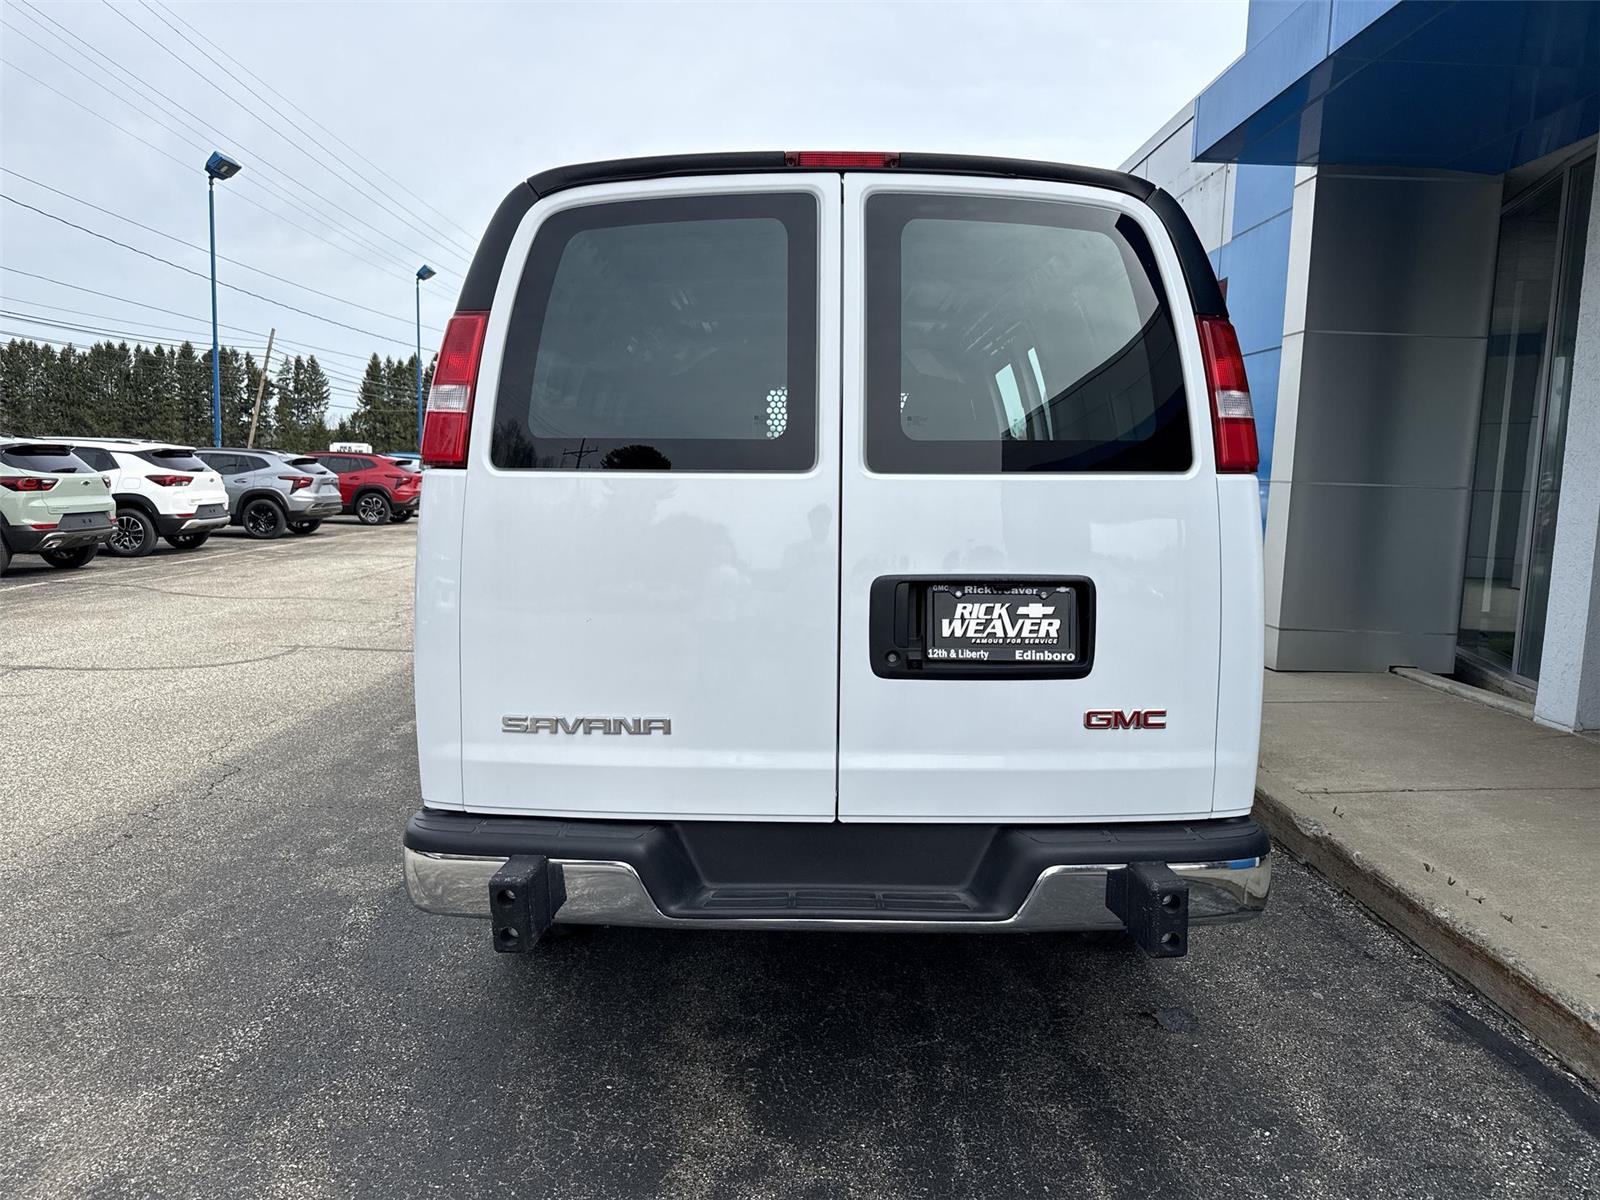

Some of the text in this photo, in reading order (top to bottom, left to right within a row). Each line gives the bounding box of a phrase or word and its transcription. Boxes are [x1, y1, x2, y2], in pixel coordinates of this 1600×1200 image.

[954, 603, 1011, 619] RICK
[941, 618, 1061, 638] WEAVER
[928, 649, 989, 660] 12th & Liberty
[1015, 650, 1076, 661] Edinboro
[502, 716, 672, 735] SAVANA
[1083, 709, 1167, 730] GMC
